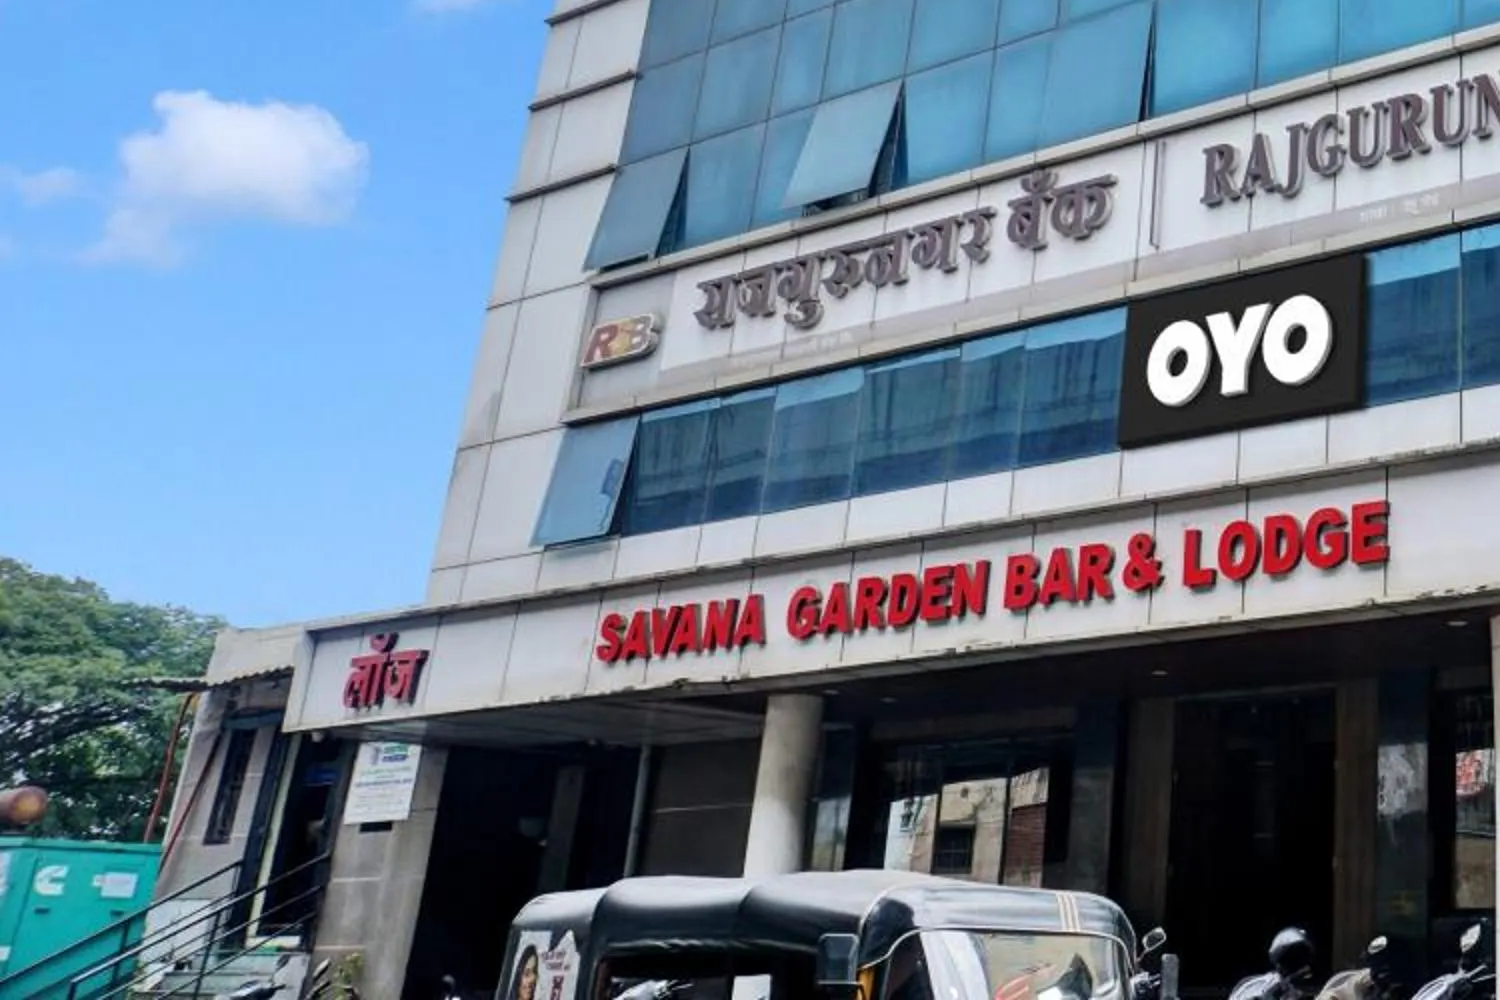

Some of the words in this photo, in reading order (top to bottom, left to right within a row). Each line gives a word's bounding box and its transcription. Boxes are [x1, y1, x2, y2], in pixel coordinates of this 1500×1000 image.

[1146, 293, 1334, 408] OYO
[596, 591, 768, 666] SAVANA
[786, 560, 991, 639] GARDEN
[1182, 500, 1392, 594] LODGE
[341, 633, 430, 713] लॉज
